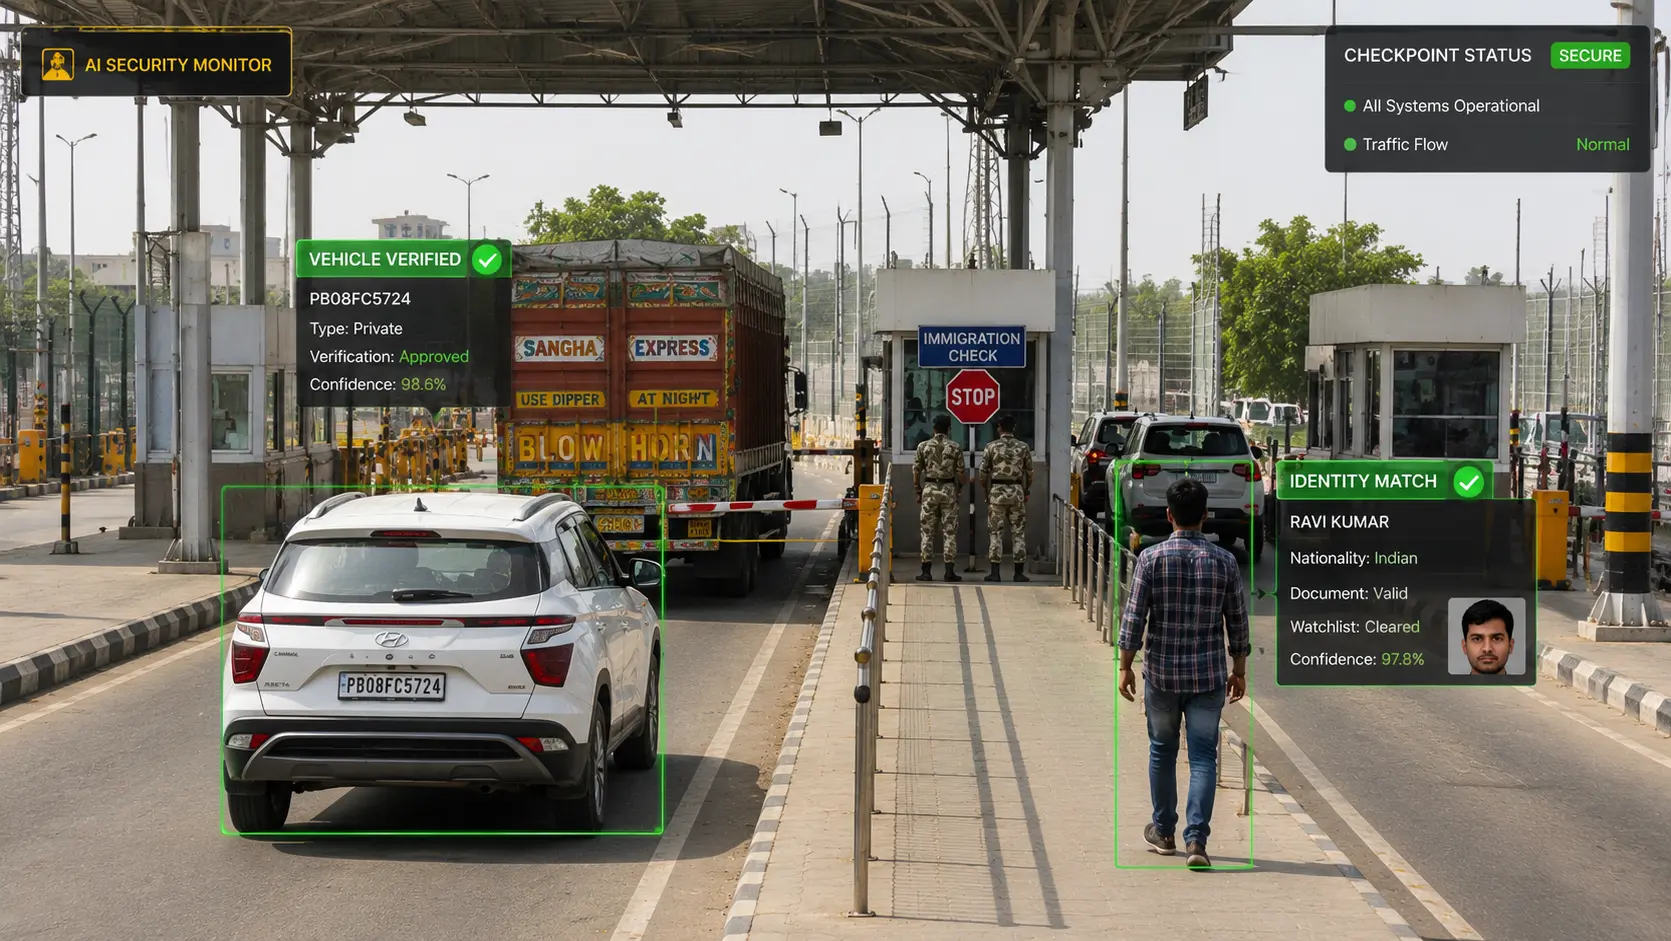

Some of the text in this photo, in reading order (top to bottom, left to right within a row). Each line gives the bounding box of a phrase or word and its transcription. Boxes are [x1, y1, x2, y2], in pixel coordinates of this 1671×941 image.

[923, 332, 1020, 345] IMMIGRATION
[523, 338, 711, 358] SANGHA EXPRESS
[948, 349, 998, 362] CHECK
[521, 392, 711, 406] USE DIPPER AT NIGHT
[951, 388, 996, 406] STOP
[518, 433, 714, 462] BLOW HORN
[347, 677, 441, 694] PB08FC5724
